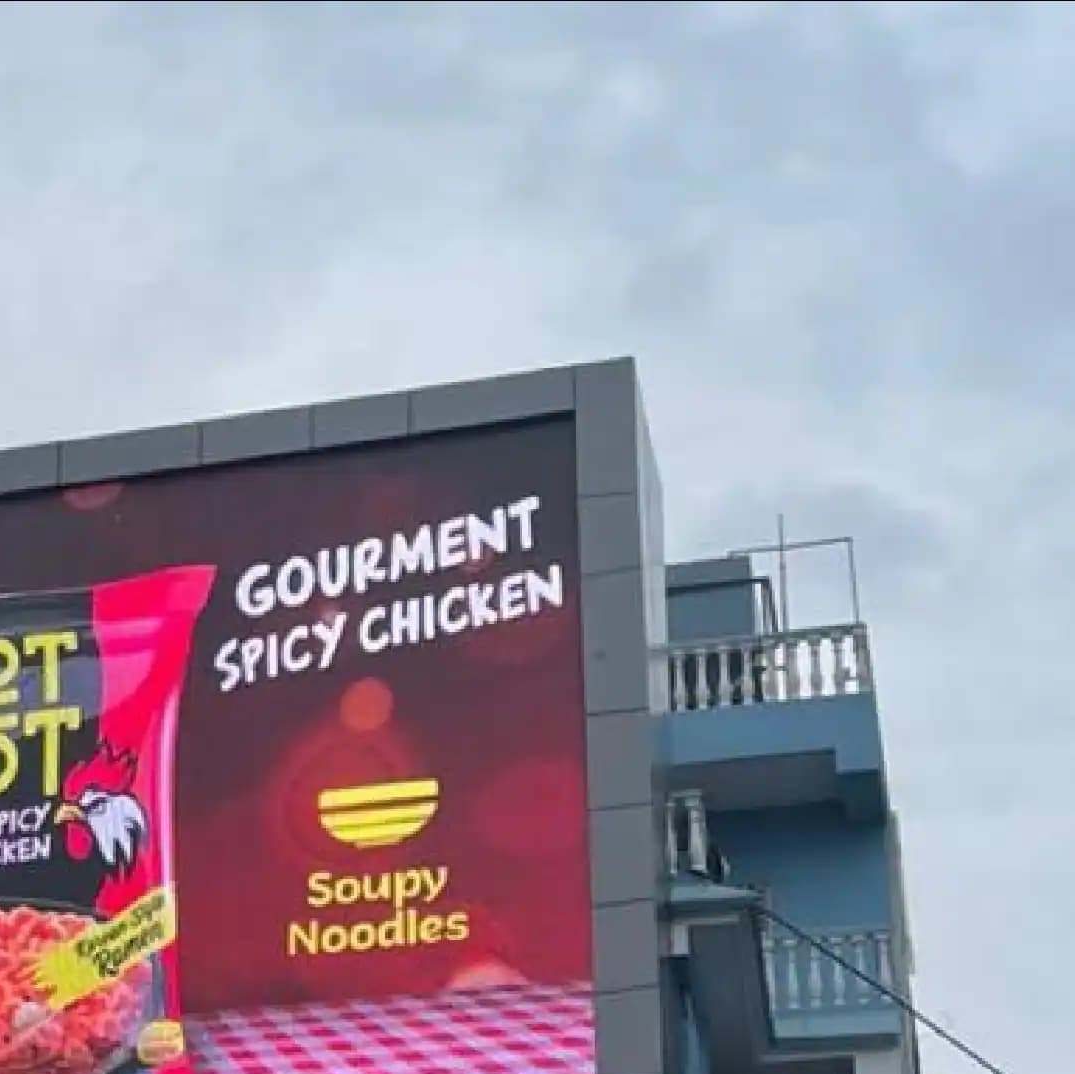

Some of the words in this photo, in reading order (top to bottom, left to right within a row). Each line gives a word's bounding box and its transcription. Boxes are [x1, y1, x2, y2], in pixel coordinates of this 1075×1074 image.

[236, 494, 540, 616] GOURMENT
[214, 611, 348, 691] SPICY
[359, 563, 563, 653] CHICKEN
[307, 865, 449, 909] Soupy
[286, 908, 471, 957] Noodles
